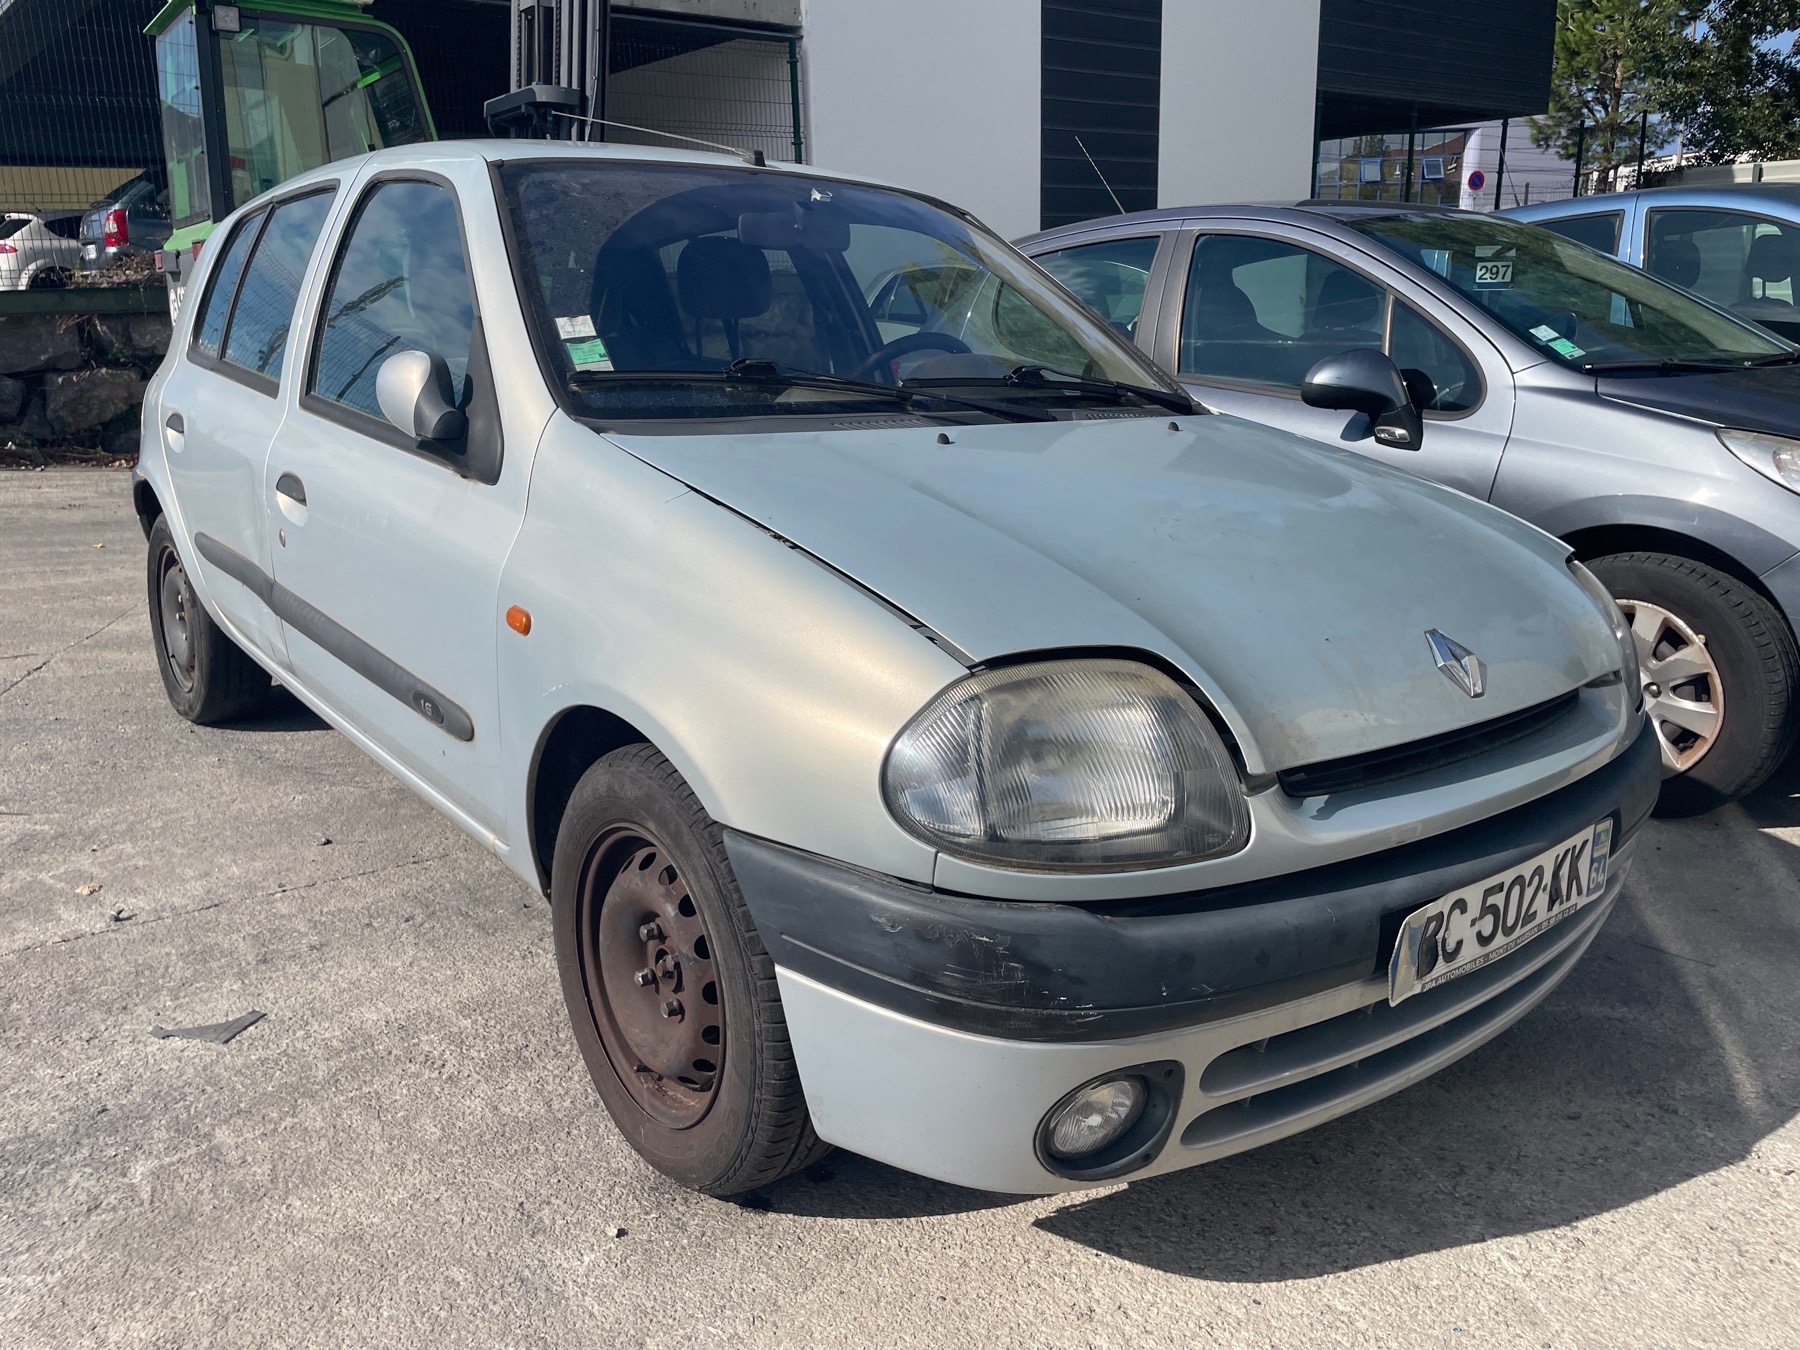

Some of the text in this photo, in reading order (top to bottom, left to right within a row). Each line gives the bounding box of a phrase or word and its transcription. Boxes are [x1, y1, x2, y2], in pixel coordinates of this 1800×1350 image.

[1478, 264, 1511, 280] 297
[1589, 859, 1605, 889] 64
[1436, 956, 1485, 985] AUTOMOBILES
[1488, 945, 1508, 960] MONT
[1508, 940, 1516, 951] DE
[1516, 926, 1538, 945] MARSAN
